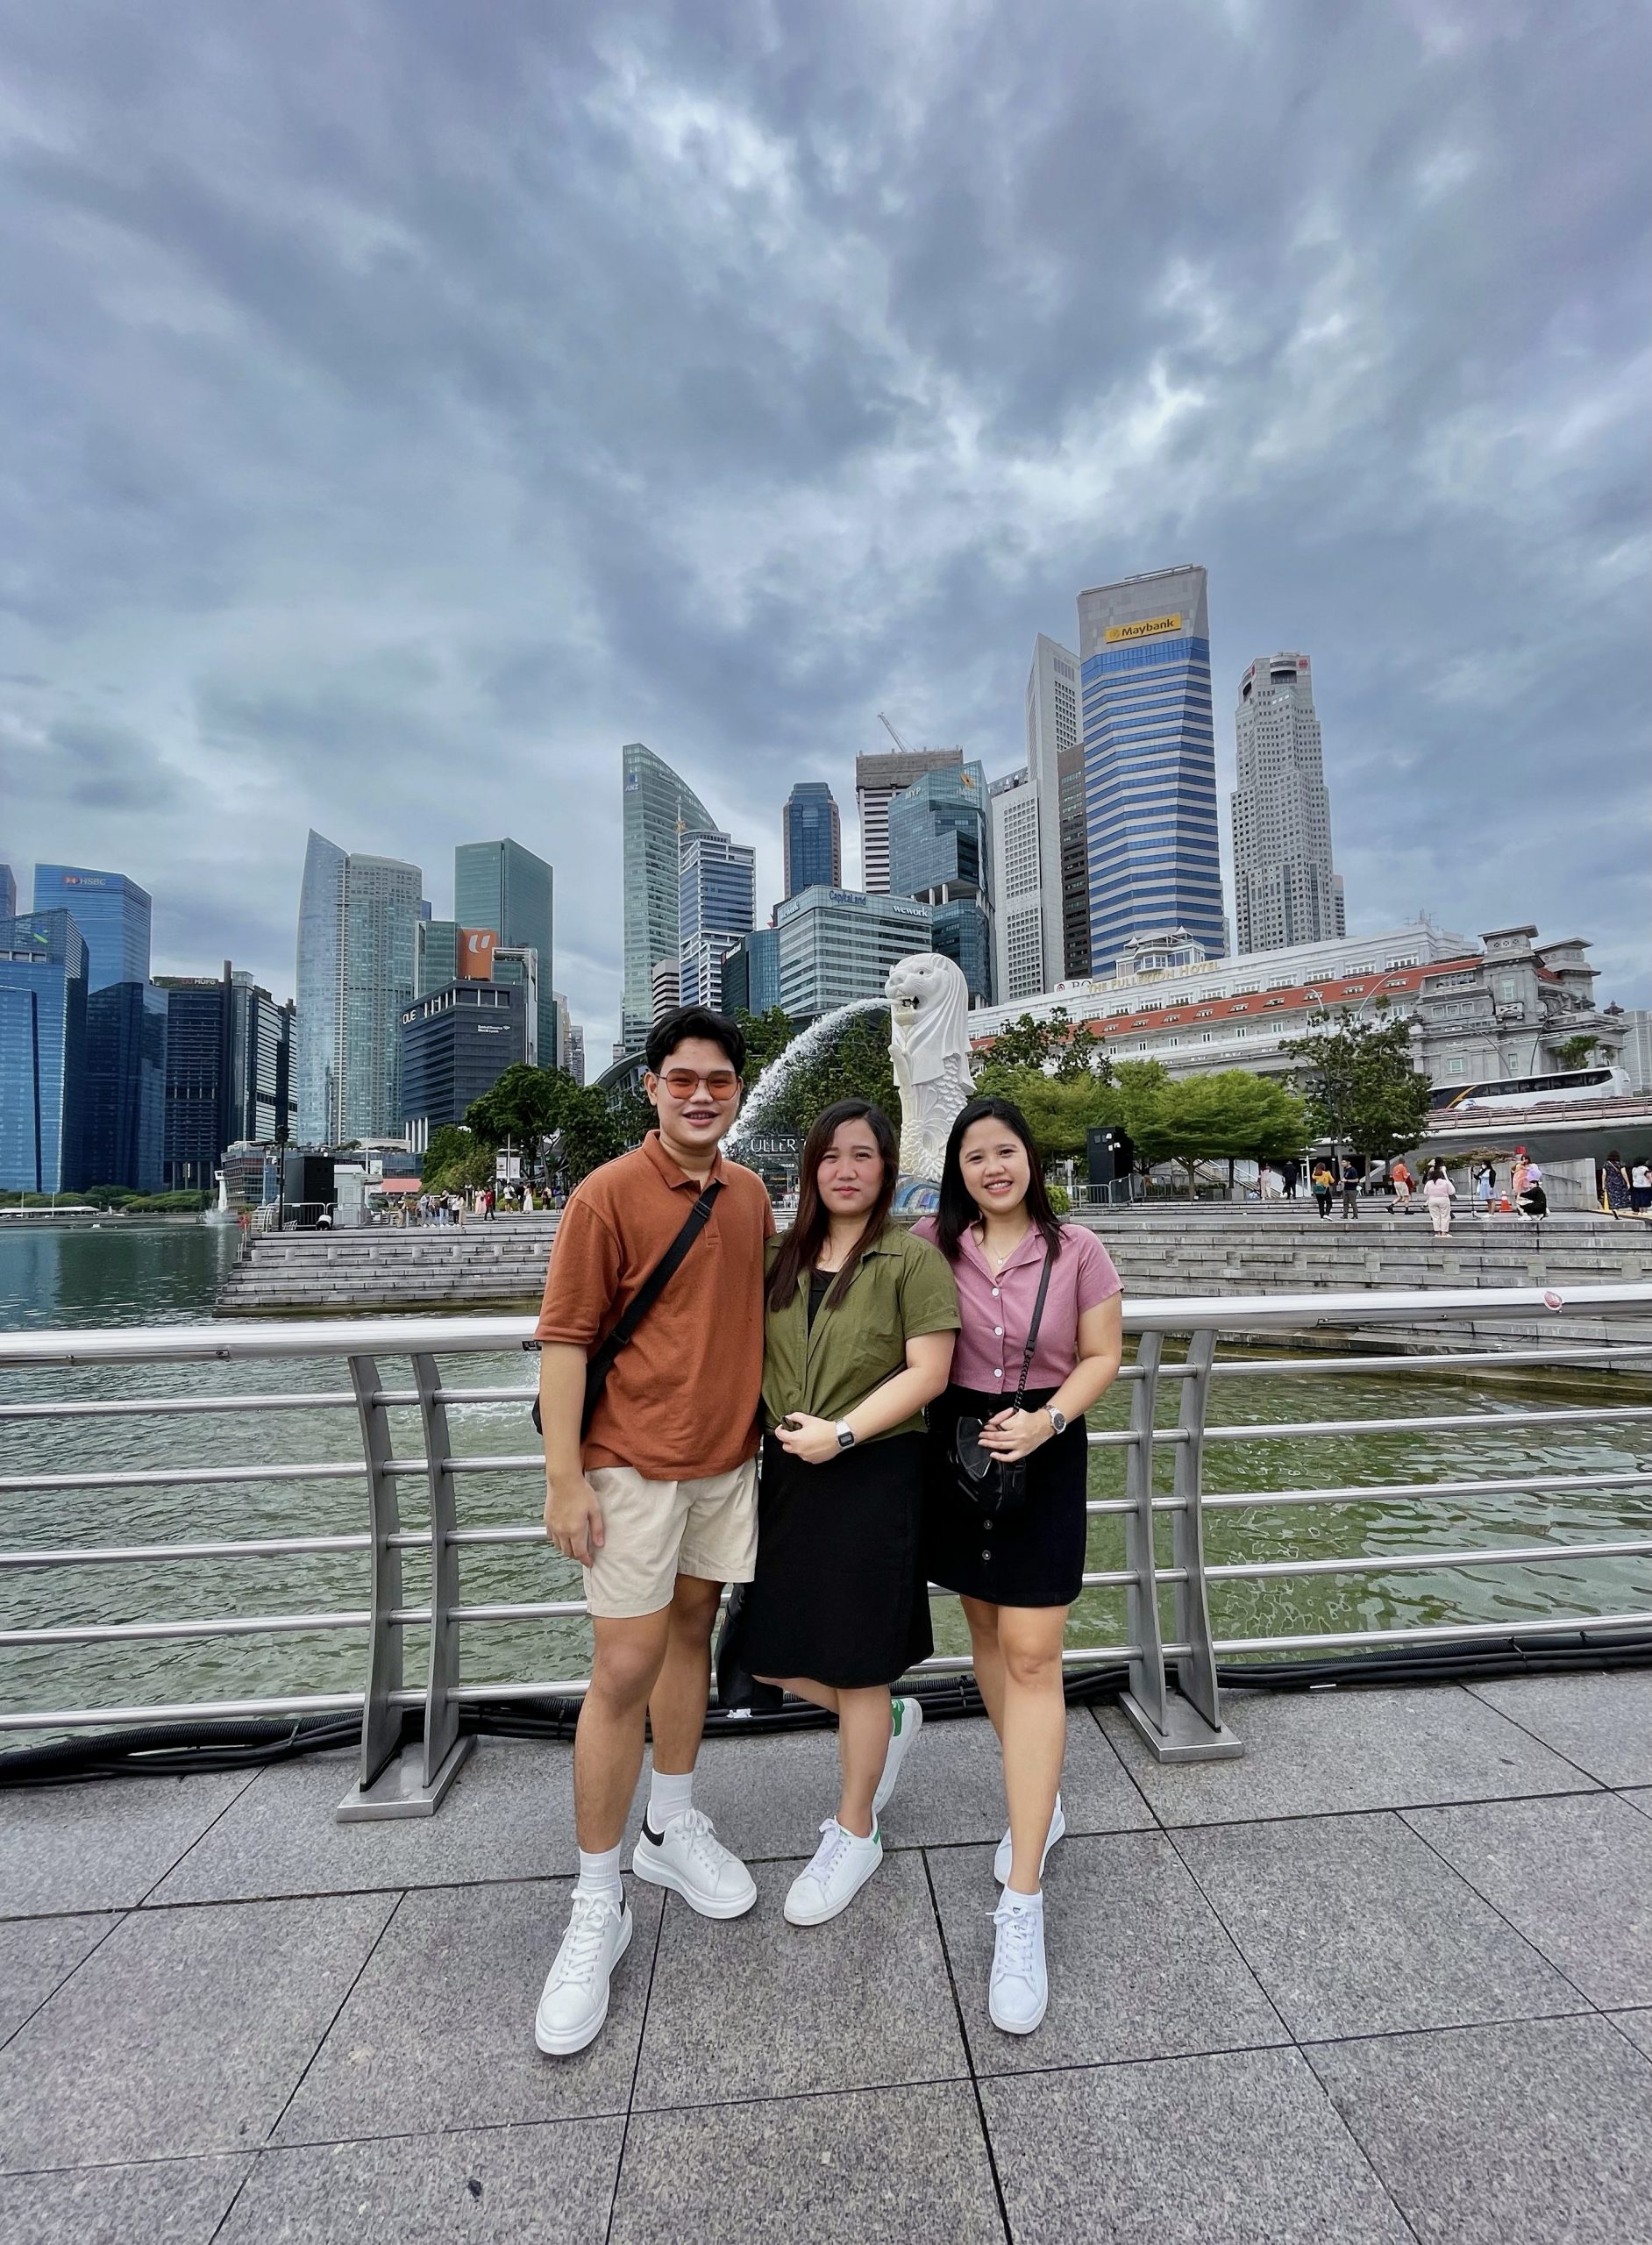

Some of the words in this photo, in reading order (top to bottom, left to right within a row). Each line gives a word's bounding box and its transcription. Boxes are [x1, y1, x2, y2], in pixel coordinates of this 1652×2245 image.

[1122, 619, 1174, 637] Maybank
[624, 783, 640, 793] ANZ
[905, 787, 922, 800] MYP
[80, 877, 106, 886] HSBC
[829, 890, 867, 906] CapitaLand
[893, 903, 929, 917] wework
[1087, 982, 1107, 994] THE
[1111, 969, 1175, 990] FULLERTON
[1178, 962, 1221, 977] HOTEL
[750, 1138, 806, 1152] ULLER
